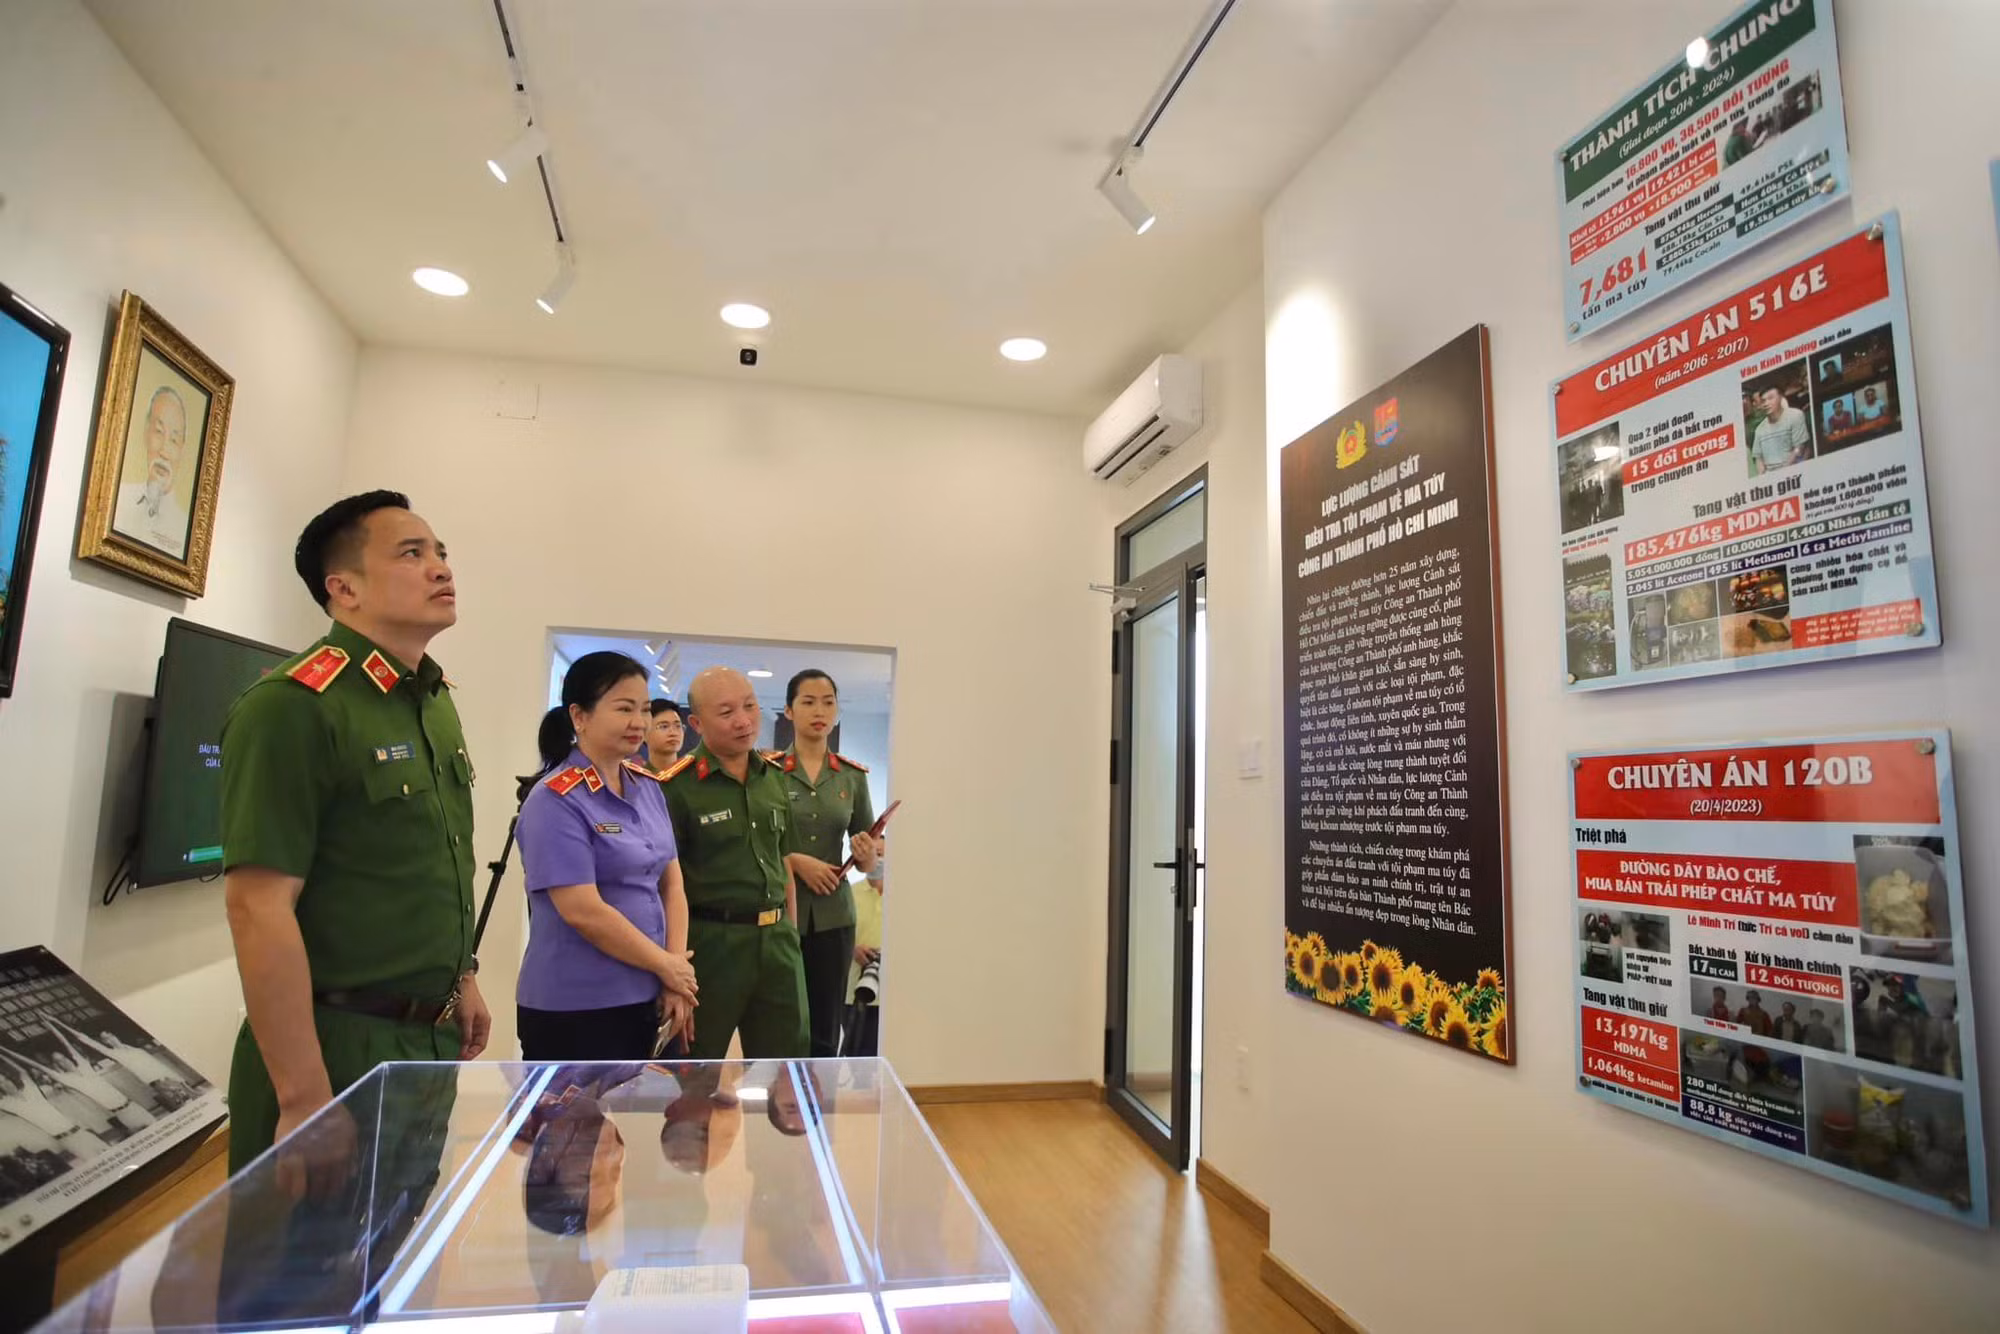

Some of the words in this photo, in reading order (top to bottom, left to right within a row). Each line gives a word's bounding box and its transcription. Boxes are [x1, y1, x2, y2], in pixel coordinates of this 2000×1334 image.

[1570, 109, 1637, 170] THÀNH
[1644, 60, 1696, 115] TÍCH
[1644, 217, 1665, 235] Tang
[1684, 195, 1700, 211] thu
[1580, 249, 1646, 304] 7,681
[1582, 304, 1600, 320] tấn
[1605, 292, 1622, 307] ma
[1627, 277, 1647, 294] túy
[1595, 331, 1688, 390] CHUYÊN
[1698, 306, 1738, 344] ÁN
[1749, 265, 1826, 319] 516E
[1654, 369, 1681, 389] (năm
[1682, 353, 1708, 374] 2016
[1717, 336, 1748, 359] 2017)
[1645, 426, 1651, 437] 2
[1652, 419, 1669, 435] giai
[1632, 458, 1648, 477] 15
[1653, 448, 1677, 468] đối
[1682, 434, 1728, 458] tượng
[1321, 495, 1337, 516] LỰC
[1339, 480, 1368, 508] LƯỢNG
[1399, 454, 1419, 479] SÁT
[1630, 477, 1655, 493] trong
[1657, 465, 1693, 484] chuyên
[1695, 459, 1708, 471] án
[1324, 520, 1341, 540] TRA
[1342, 512, 1357, 533] TỘI
[1359, 499, 1387, 525] PHẠM
[1388, 487, 1402, 512] VỀ
[1404, 484, 1421, 506] MA
[1423, 472, 1445, 497] TÚY
[1693, 500, 1722, 518] Tang
[1725, 491, 1746, 508] vật
[1750, 485, 1773, 501] thu
[1777, 474, 1801, 495] giữ
[1628, 525, 1721, 560] 185,476kg
[1727, 502, 1794, 533] MDMA
[1790, 523, 1825, 538] 4.400
[1828, 516, 1861, 530] Nhân
[1864, 509, 1889, 521] dân
[1893, 503, 1906, 515] tệ
[1298, 555, 1320, 577] CÔNG
[1321, 550, 1333, 568] AN
[1334, 537, 1364, 562] THÀNH
[1365, 523, 1386, 551] PHỐ
[1388, 517, 1403, 542] HỒ
[1405, 509, 1424, 535] CHÍ
[1427, 499, 1457, 526] MINH
[1726, 533, 1784, 555] 10.000USD
[1802, 543, 1810, 554] 6
[1813, 542, 1826, 554] tạ
[1828, 523, 1910, 547] Methylamine
[1388, 565, 1398, 578] 25
[1400, 561, 1416, 574] năm
[1448, 561, 1460, 575] sát
[1694, 551, 1719, 566] đồng
[1708, 562, 1728, 575] 495
[1730, 560, 1742, 570] lít
[1745, 547, 1794, 567] Methanol
[1416, 584, 1442, 600] Thành
[1444, 575, 1461, 596] phố
[1628, 580, 1652, 594] 2.045
[1654, 579, 1664, 588] lít
[1667, 571, 1703, 585] Acetone
[1423, 619, 1439, 631] anh
[1440, 614, 1462, 627] hùng
[1608, 759, 1711, 788] CHUYÊN
[1722, 755, 1767, 786] ÁN
[1785, 755, 1872, 785] 120B
[1690, 799, 1761, 815] (20/4/2023)
[1576, 827, 1601, 843] Triệt
[1604, 828, 1626, 844] phá
[1453, 848, 1469, 863] phá
[1620, 859, 1670, 876] ĐƯỜNG
[1673, 862, 1702, 878] DÂY
[1706, 864, 1739, 881] BÀO
[1743, 865, 1780, 885] CHẾ,
[1585, 877, 1612, 891] MUA
[1615, 877, 1642, 893] BÁN
[1645, 881, 1677, 896] TRÁI
[1681, 883, 1716, 900] PHÉP
[1720, 885, 1764, 904] CHẤT
[1768, 891, 1796, 908] MA
[1800, 892, 1836, 911] TÚY
[1453, 902, 1471, 916] Bác
[1432, 916, 1455, 931] Nhân
[1699, 916, 1721, 928] Minh
[1723, 918, 1735, 930] Trí
[1693, 959, 1708, 973] 17
[1744, 950, 1759, 963] Xử
[1760, 953, 1771, 967] lý
[1774, 955, 1803, 970] hành
[1806, 960, 1842, 976] chính
[1750, 968, 1768, 983] 12
[1773, 975, 1794, 987] ĐỐI
[1797, 979, 1839, 994] TƯỢNG
[1583, 987, 1606, 1005] Tang
[1608, 994, 1625, 1009] vật
[1627, 997, 1646, 1012] thu
[1648, 1002, 1667, 1017] giữ
[1596, 1017, 1668, 1050] 13,197kg
[1613, 1040, 1646, 1058] MDMA
[1588, 1057, 1634, 1082] 1,064kg
[1637, 1073, 1674, 1091] ketamine
[1686, 1076, 1704, 1088] 280
[1706, 1083, 1717, 1092] ml
[1690, 1099, 1715, 1115] 88,8
[1718, 1107, 1732, 1122] kg
